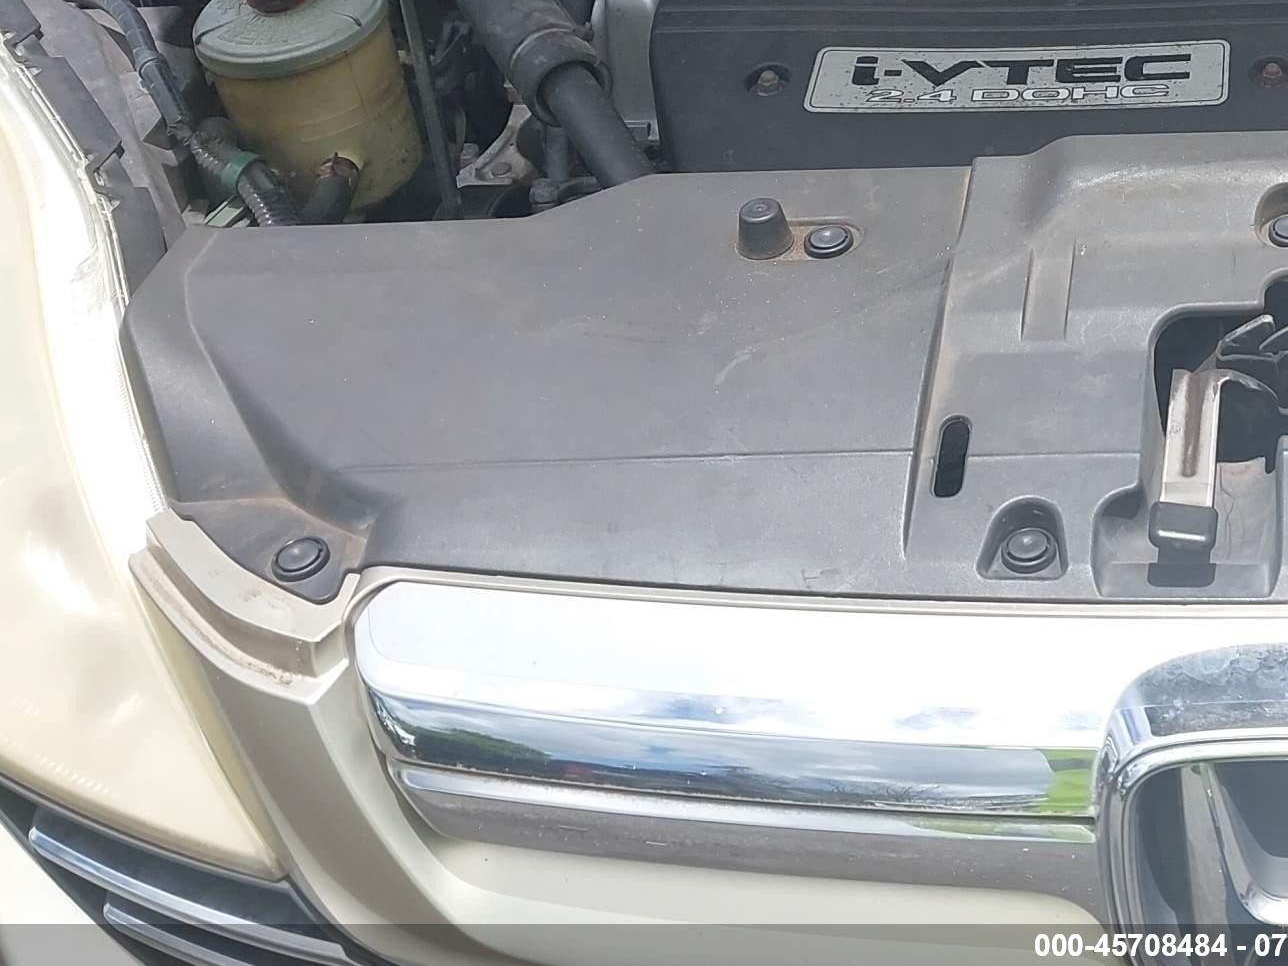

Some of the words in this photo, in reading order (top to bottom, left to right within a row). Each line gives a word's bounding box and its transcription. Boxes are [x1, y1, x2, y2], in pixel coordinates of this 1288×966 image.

[851, 53, 1192, 86] i-VTEC
[867, 87, 958, 103] 2.4
[970, 84, 1170, 102] DOHC
